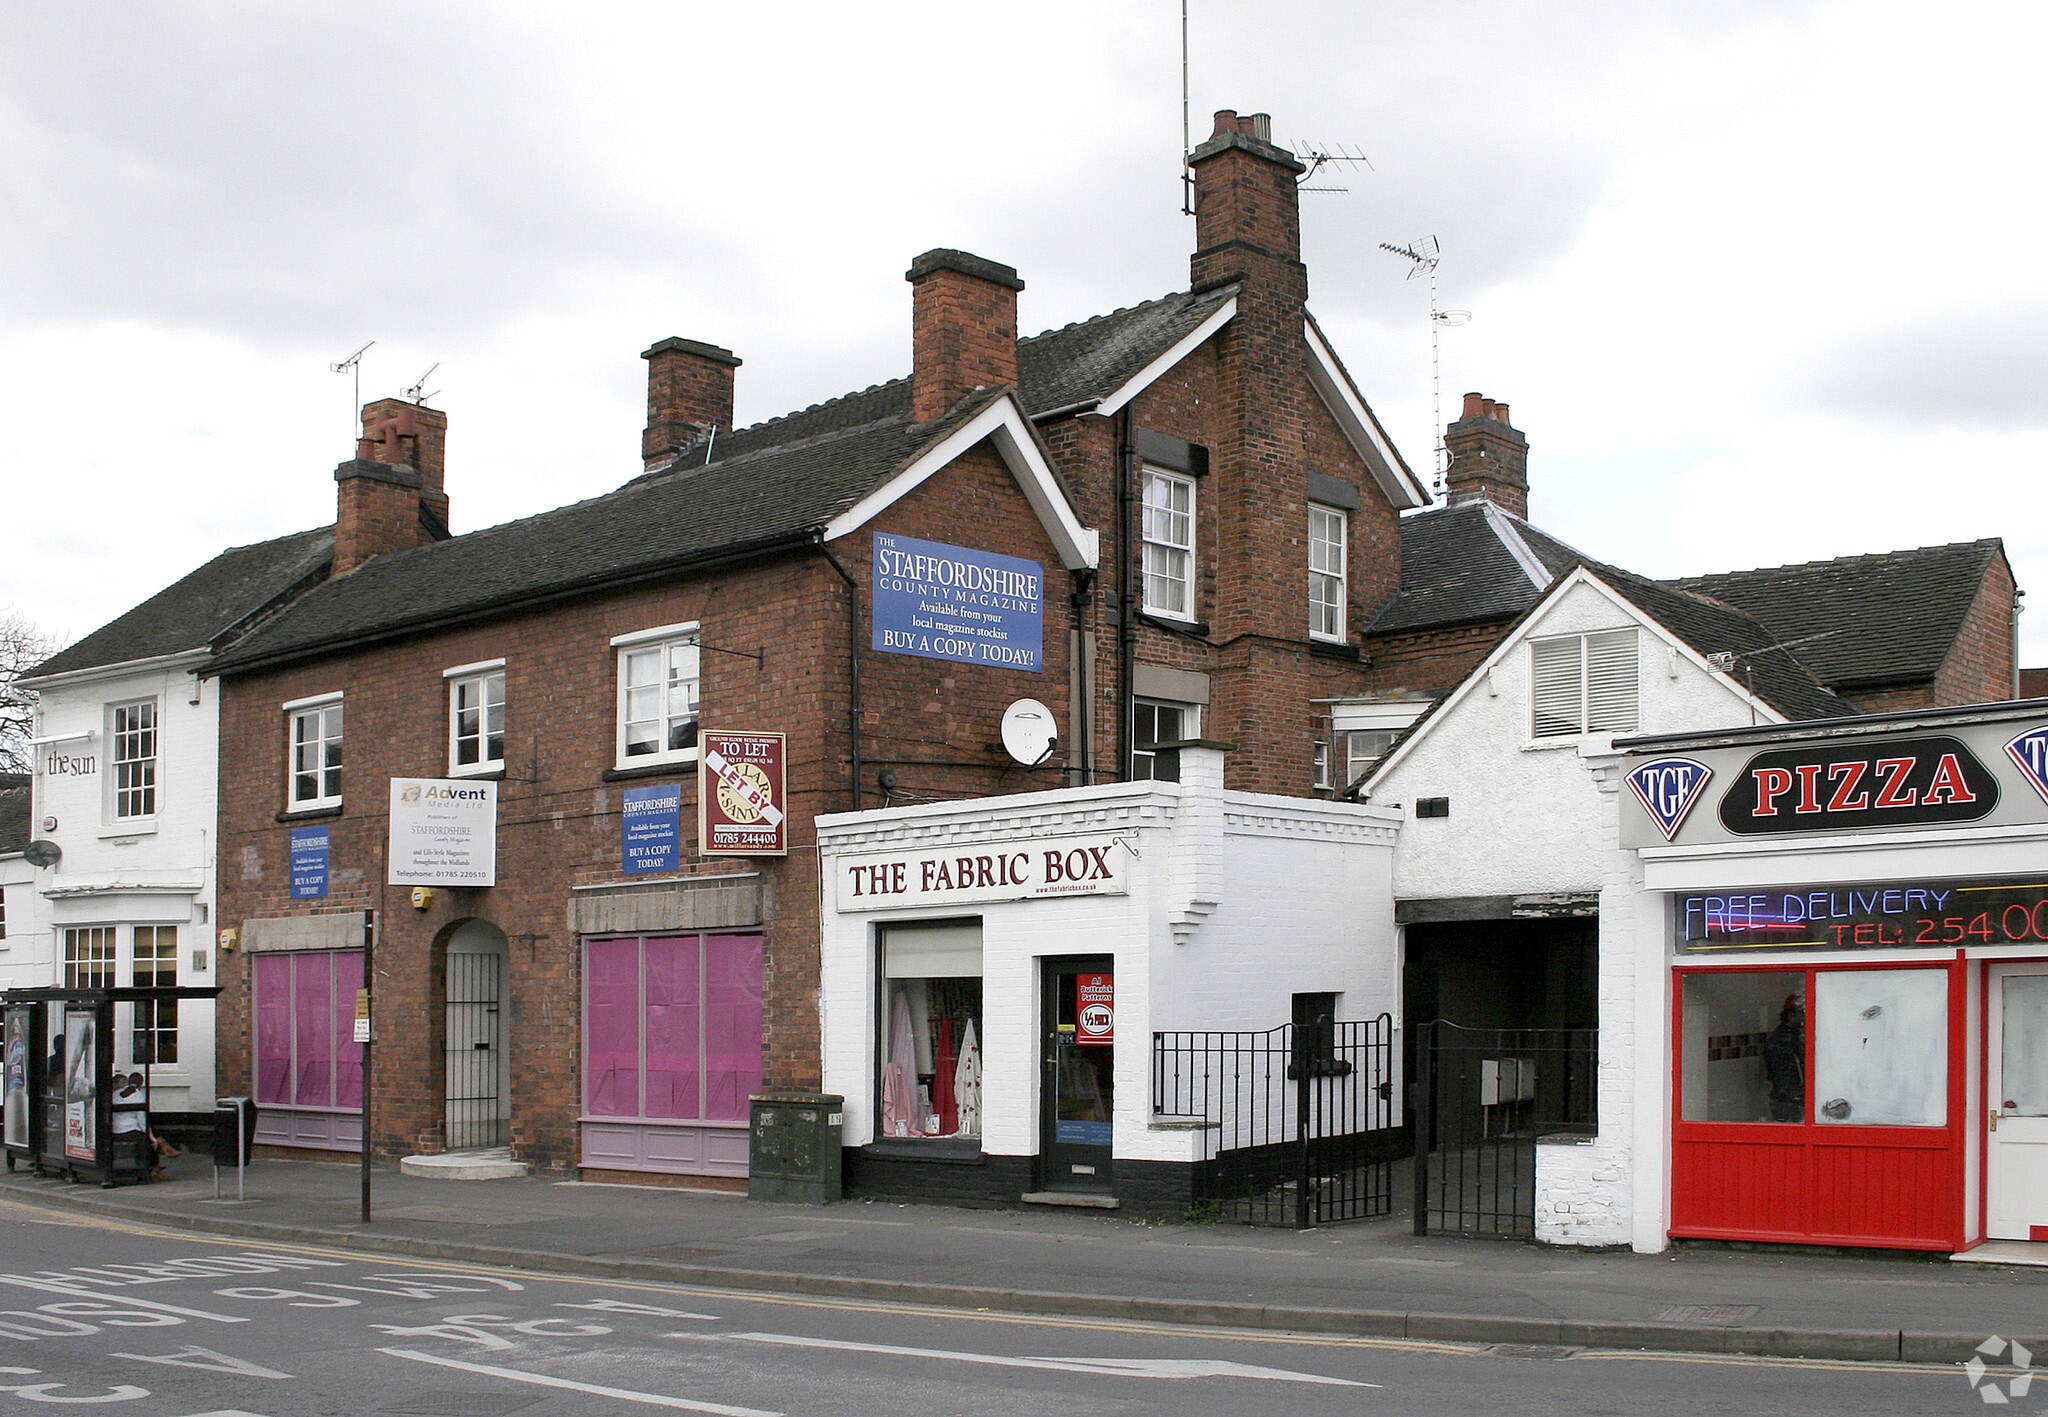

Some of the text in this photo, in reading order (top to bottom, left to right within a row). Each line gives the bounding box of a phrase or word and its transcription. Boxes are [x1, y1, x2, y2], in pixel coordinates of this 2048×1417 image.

[878, 537, 896, 547] THE
[878, 549, 1039, 600] STAFFORDSHIRE
[880, 578, 1038, 614] COUNTY MAGAZINE
[918, 600, 1002, 624] Available from your
[912, 615, 1008, 640] local magazine stockist
[883, 629, 1034, 666] BUY A COPY TODAY!
[720, 742, 770, 757] TO LET
[2025, 736, 2048, 782] T
[48, 750, 96, 776] the sun
[425, 786, 486, 800] Advent
[719, 763, 770, 811] LET BY
[1642, 766, 1692, 818] TGF
[1752, 754, 1976, 817] PIZZA
[428, 800, 483, 809] Media Ltd
[623, 797, 678, 813] STAFFORDSHIRE
[722, 797, 760, 820] SAND
[412, 826, 471, 835] STAFFORDSHIRE
[714, 832, 777, 844] 01785 244400
[629, 845, 671, 857] BUY A COPY
[637, 858, 664, 868] TODAY!
[850, 846, 1113, 897] THE FABRIC BOX
[1035, 884, 1097, 893] www.thefabricbox.co.uk
[1686, 889, 1951, 941] FREE DELIVERY
[1829, 923, 1904, 946] TEL:
[1915, 911, 1995, 943] 254
[1091, 976, 1102, 985] All
[1081, 993, 1112, 1001] Patterns
